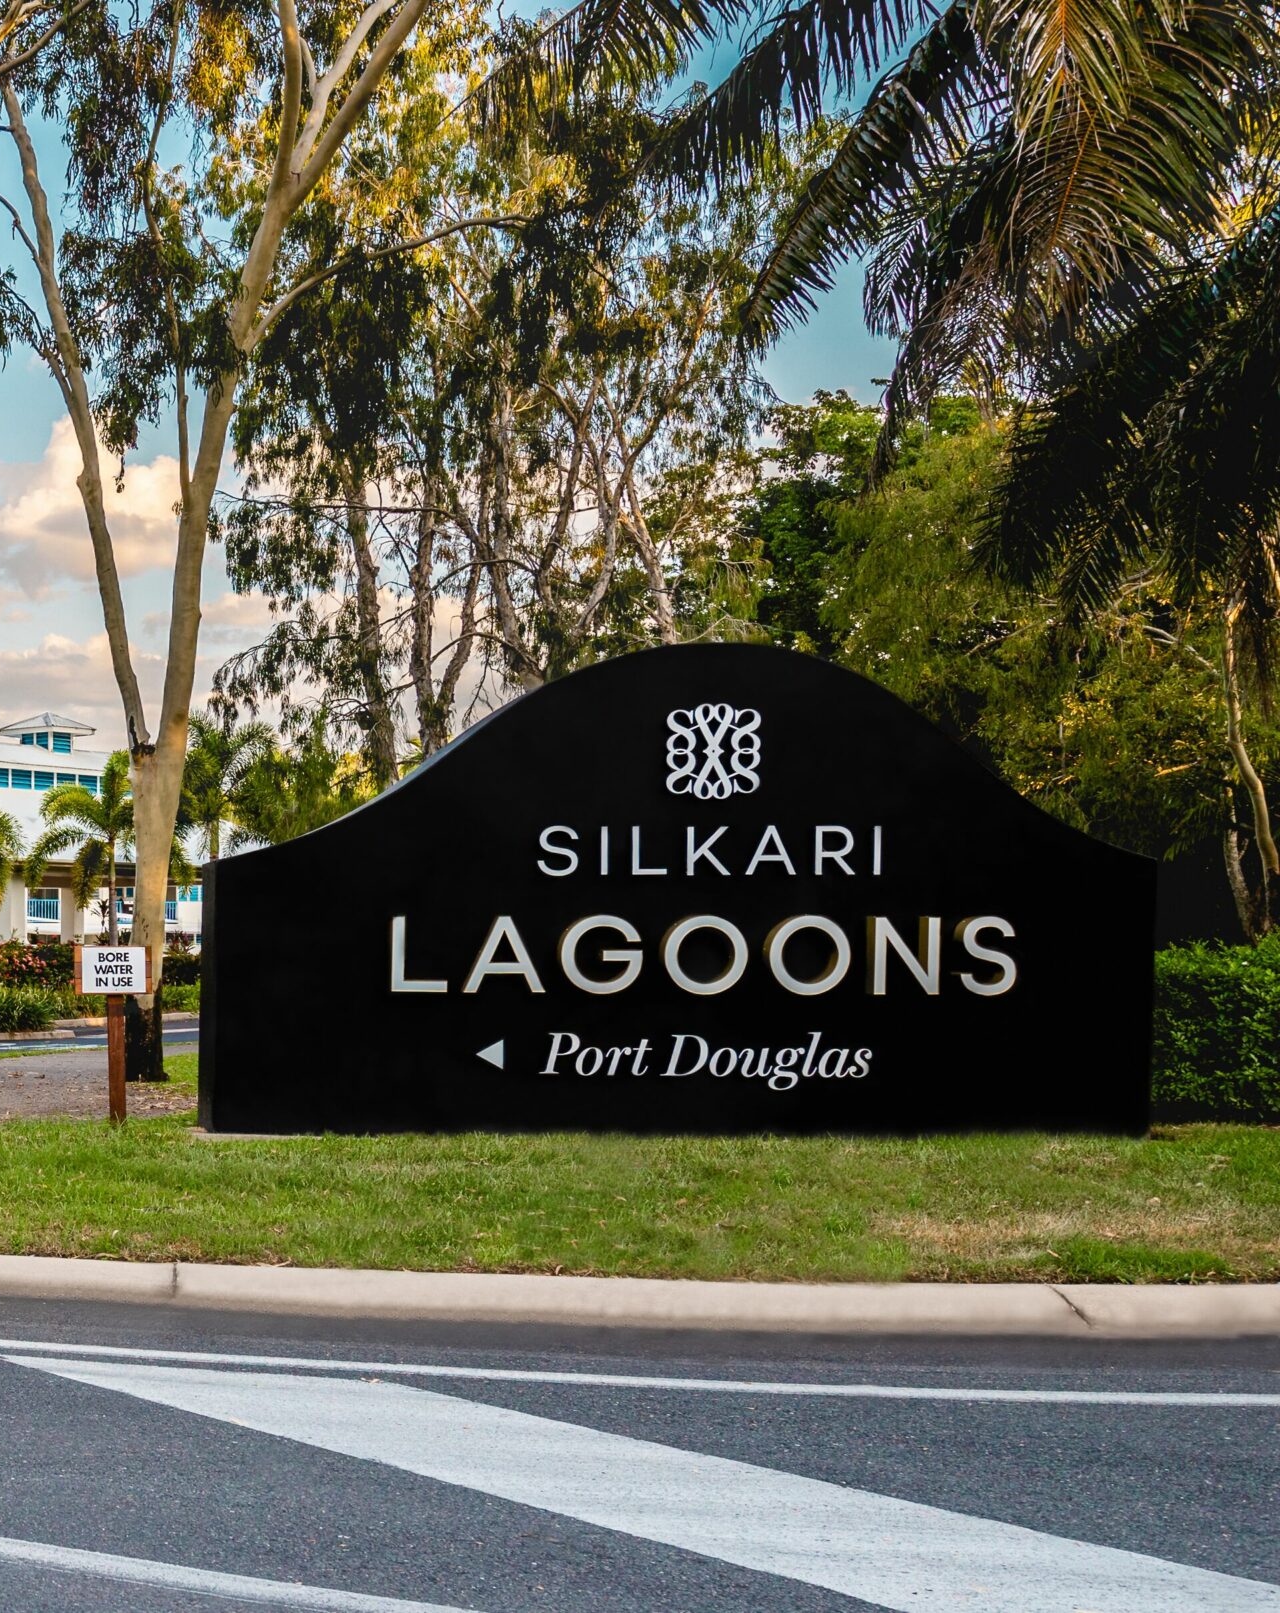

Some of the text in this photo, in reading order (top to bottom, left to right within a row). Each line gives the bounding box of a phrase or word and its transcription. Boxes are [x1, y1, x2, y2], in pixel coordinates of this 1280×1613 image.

[537, 825, 883, 877] SILKARI
[94, 965, 133, 974] WATER
[98, 952, 130, 962] BORE
[390, 914, 1018, 997] LAGOONS
[95, 977, 133, 987] IN USE
[539, 1031, 873, 1091] Port Douglas
